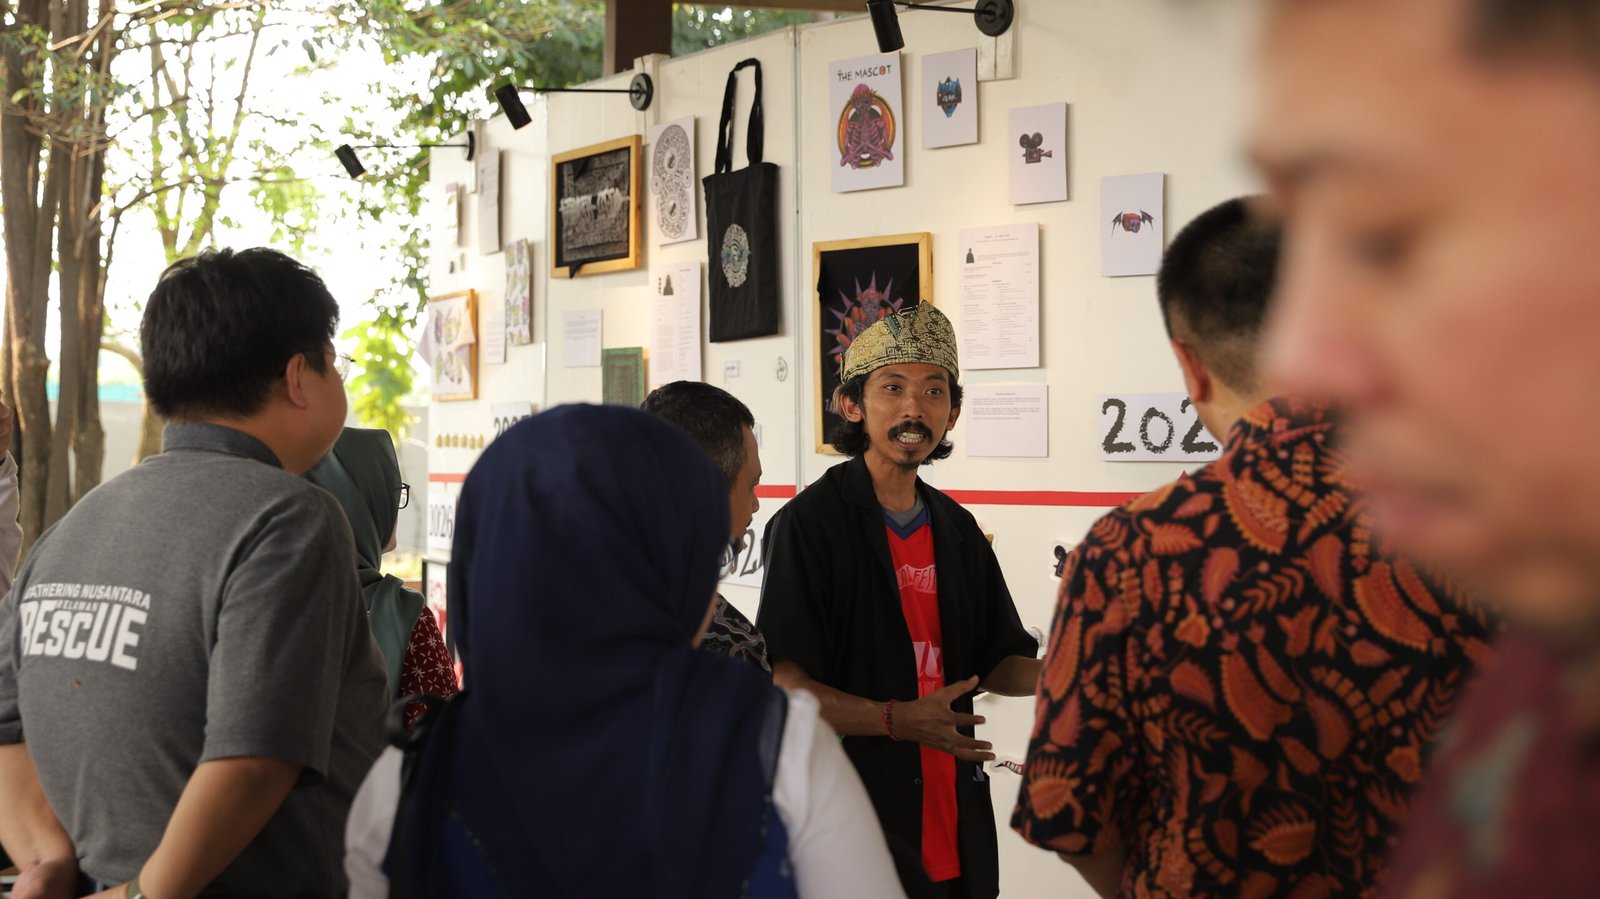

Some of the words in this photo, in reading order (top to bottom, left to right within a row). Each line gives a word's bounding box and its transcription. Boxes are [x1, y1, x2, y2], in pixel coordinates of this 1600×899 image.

[838, 71, 853, 82] THE
[855, 65, 892, 78] MASCOT
[1102, 397, 1219, 454] 202
[55, 600, 99, 612] RELAWAN
[82, 584, 151, 610] NUSANTARA
[20, 600, 148, 671] RESCUE
